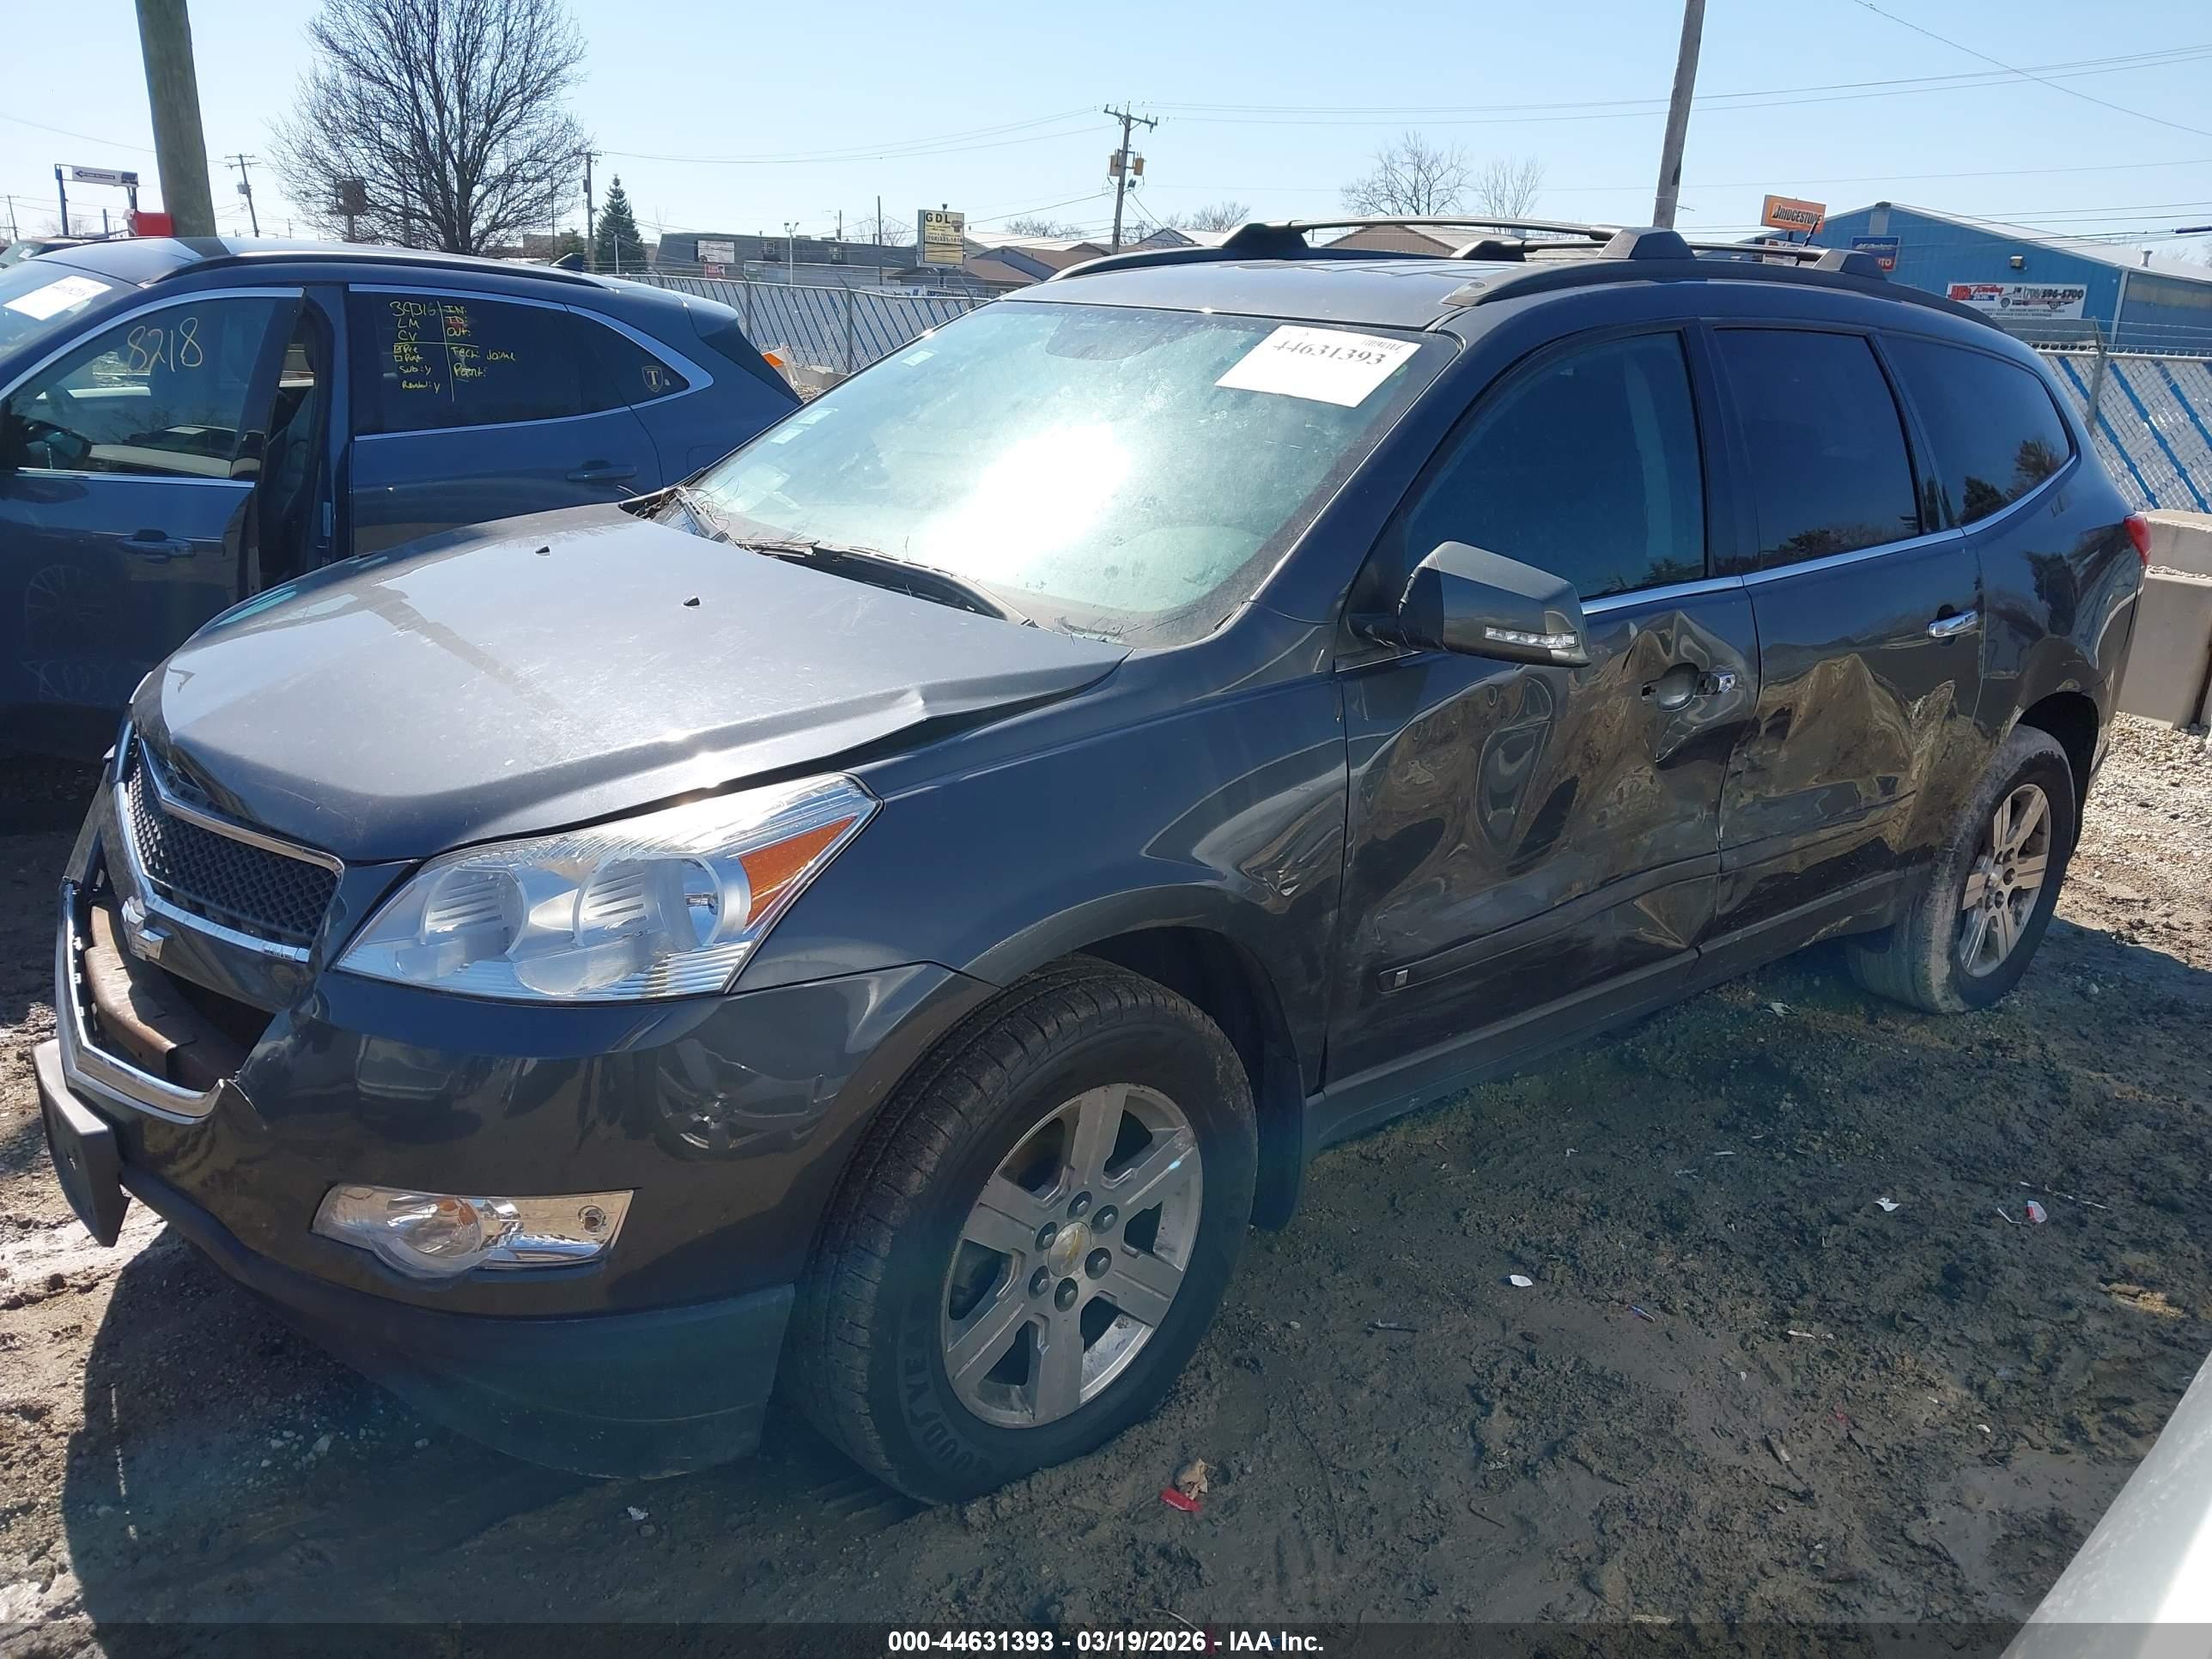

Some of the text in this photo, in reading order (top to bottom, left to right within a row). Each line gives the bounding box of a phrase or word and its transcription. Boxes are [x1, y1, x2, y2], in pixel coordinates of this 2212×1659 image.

[926, 212, 951, 224] GDL
[127, 316, 204, 373] 8218
[1272, 339, 1388, 365] 44631393
